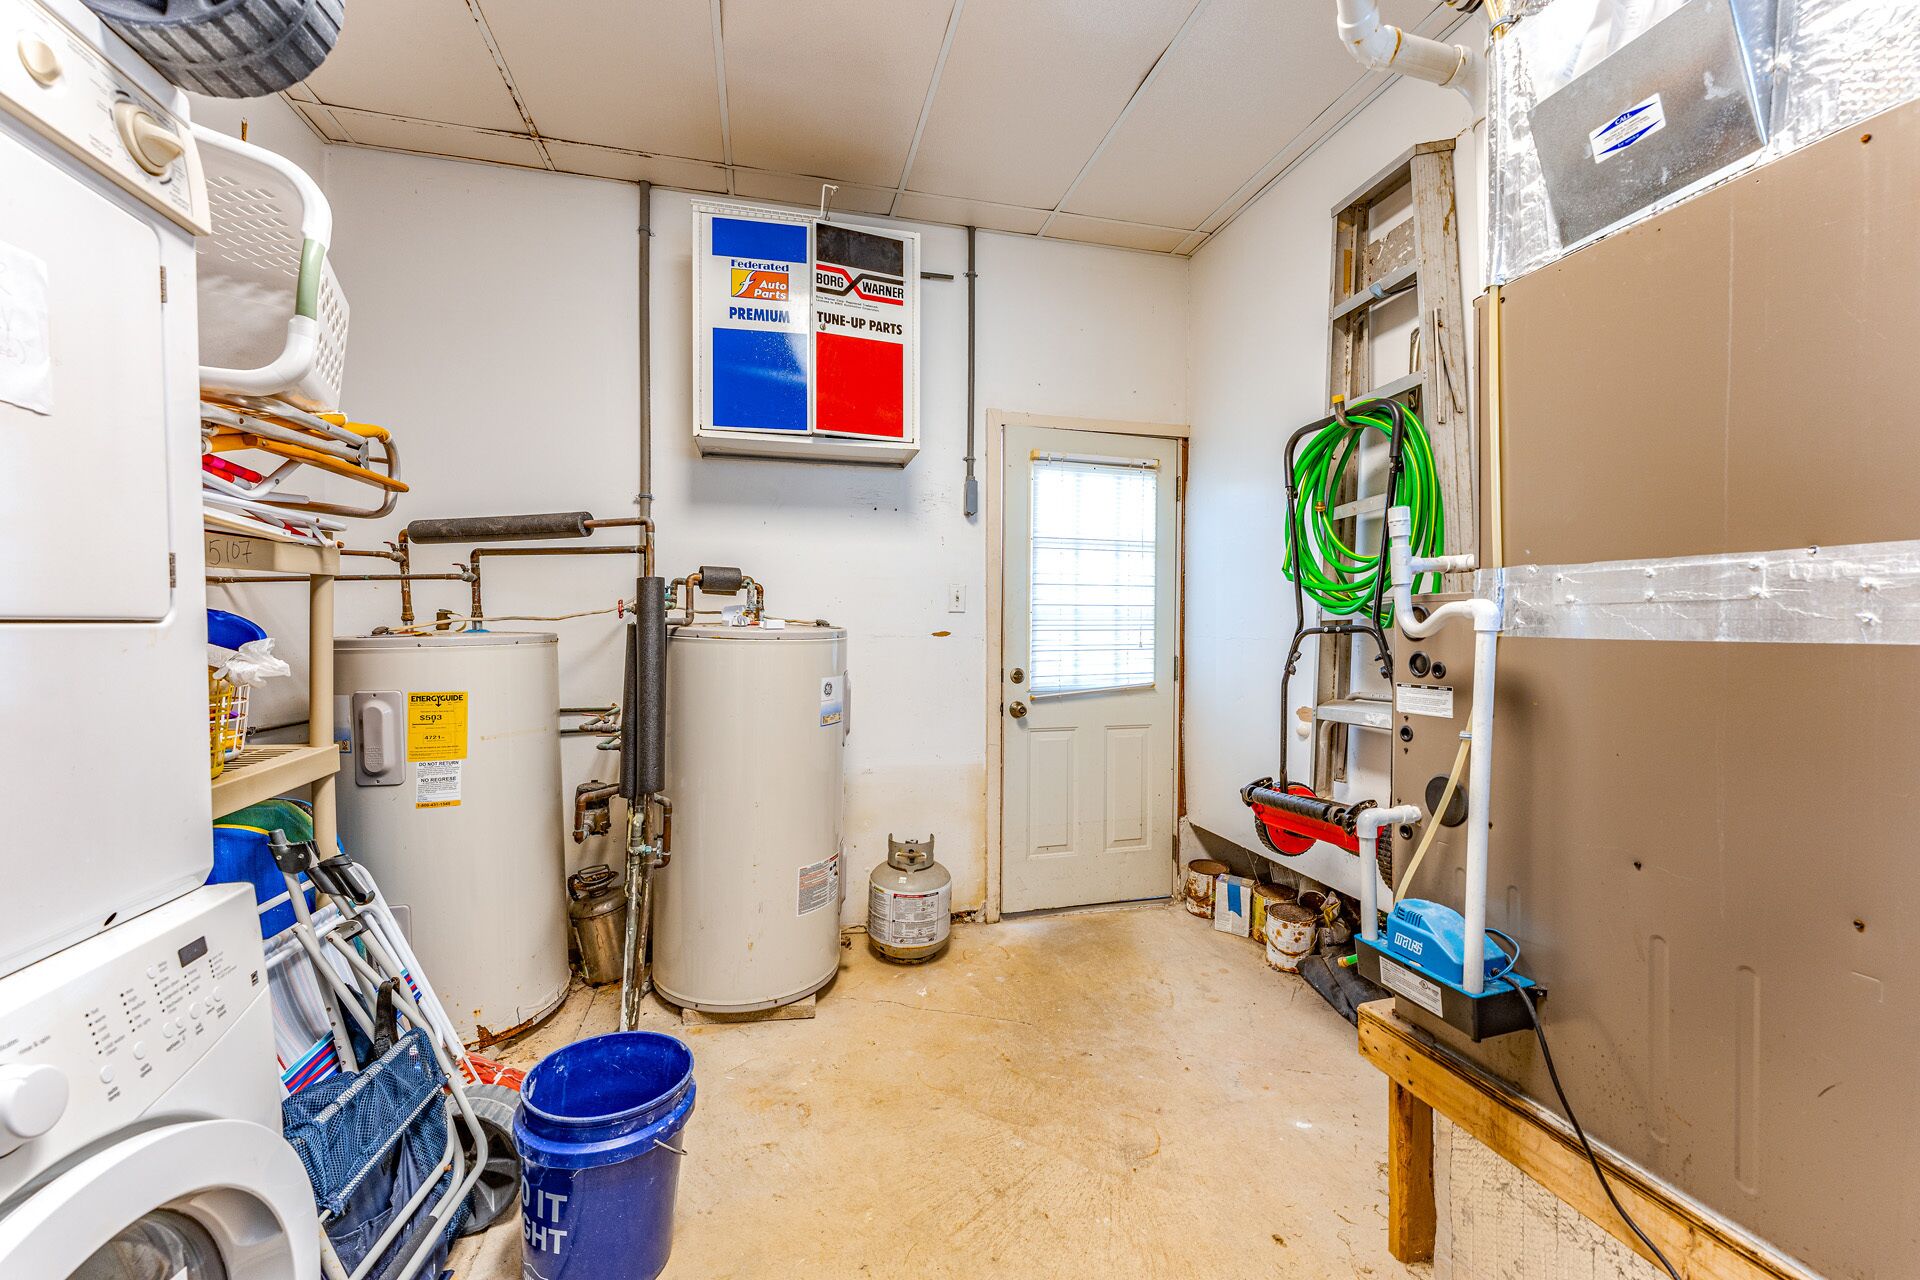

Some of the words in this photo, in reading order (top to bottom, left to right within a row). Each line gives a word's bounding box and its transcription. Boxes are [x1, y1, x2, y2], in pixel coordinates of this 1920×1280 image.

[1615, 112, 1632, 125] CALL
[731, 259, 789, 272] Federated
[759, 280, 787, 291] Auto
[816, 273, 843, 288] BORG
[862, 281, 904, 299] WARNER
[754, 289, 787, 300] Parts
[729, 307, 790, 323] PREMIUM
[816, 311, 866, 329] TUNE-UP
[869, 319, 903, 335] PARTS
[209, 539, 252, 566] 5107
[411, 694, 463, 703] ENERGYGUIDE
[521, 1174, 530, 1207] O
[537, 1189, 568, 1223] IT
[522, 1212, 568, 1255] GHT
